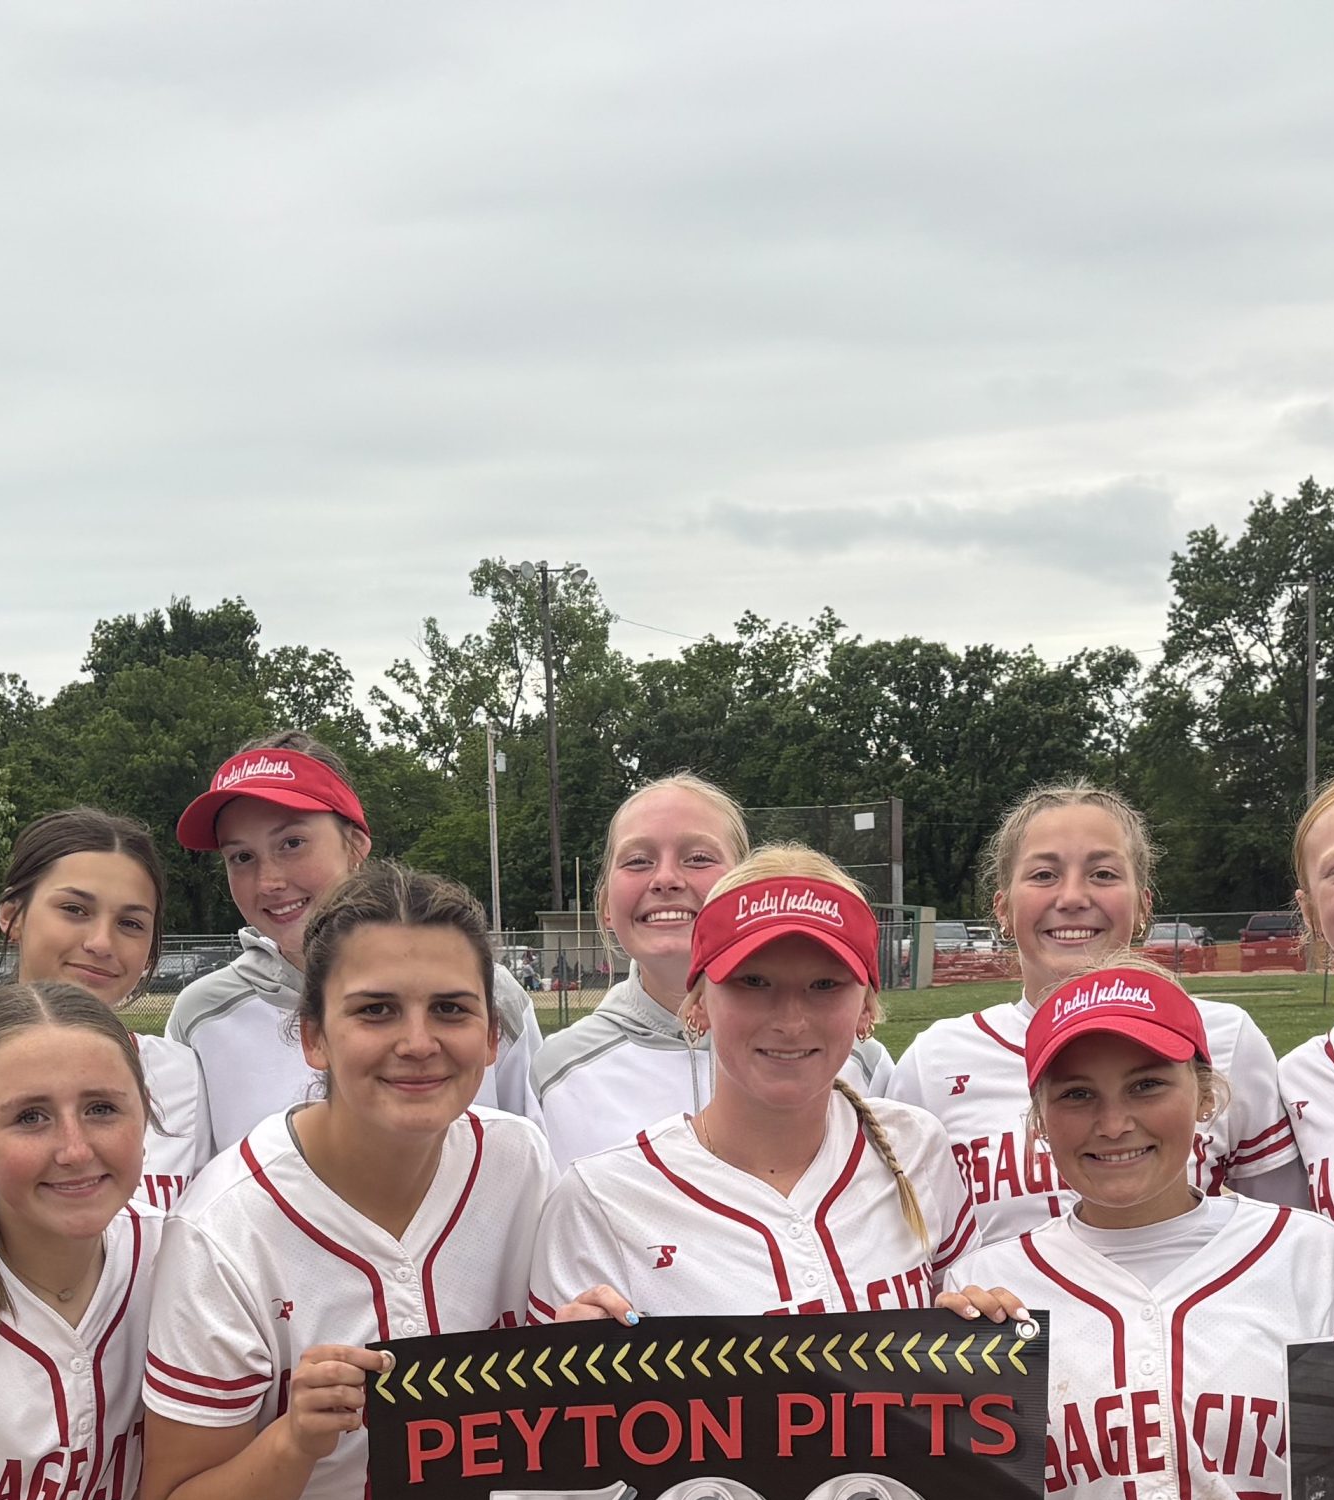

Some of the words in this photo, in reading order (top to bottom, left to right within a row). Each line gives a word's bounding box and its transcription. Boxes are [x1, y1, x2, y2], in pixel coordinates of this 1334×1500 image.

[241, 756, 289, 777] Indians
[735, 890, 779, 920] Lady
[780, 888, 839, 918] Indians
[1052, 988, 1089, 1023] Lady
[1090, 978, 1150, 1004] Indians
[406, 1396, 745, 1484] PEYTON
[777, 1392, 1018, 1459] PITTS
[1045, 1390, 1166, 1493] AGE
